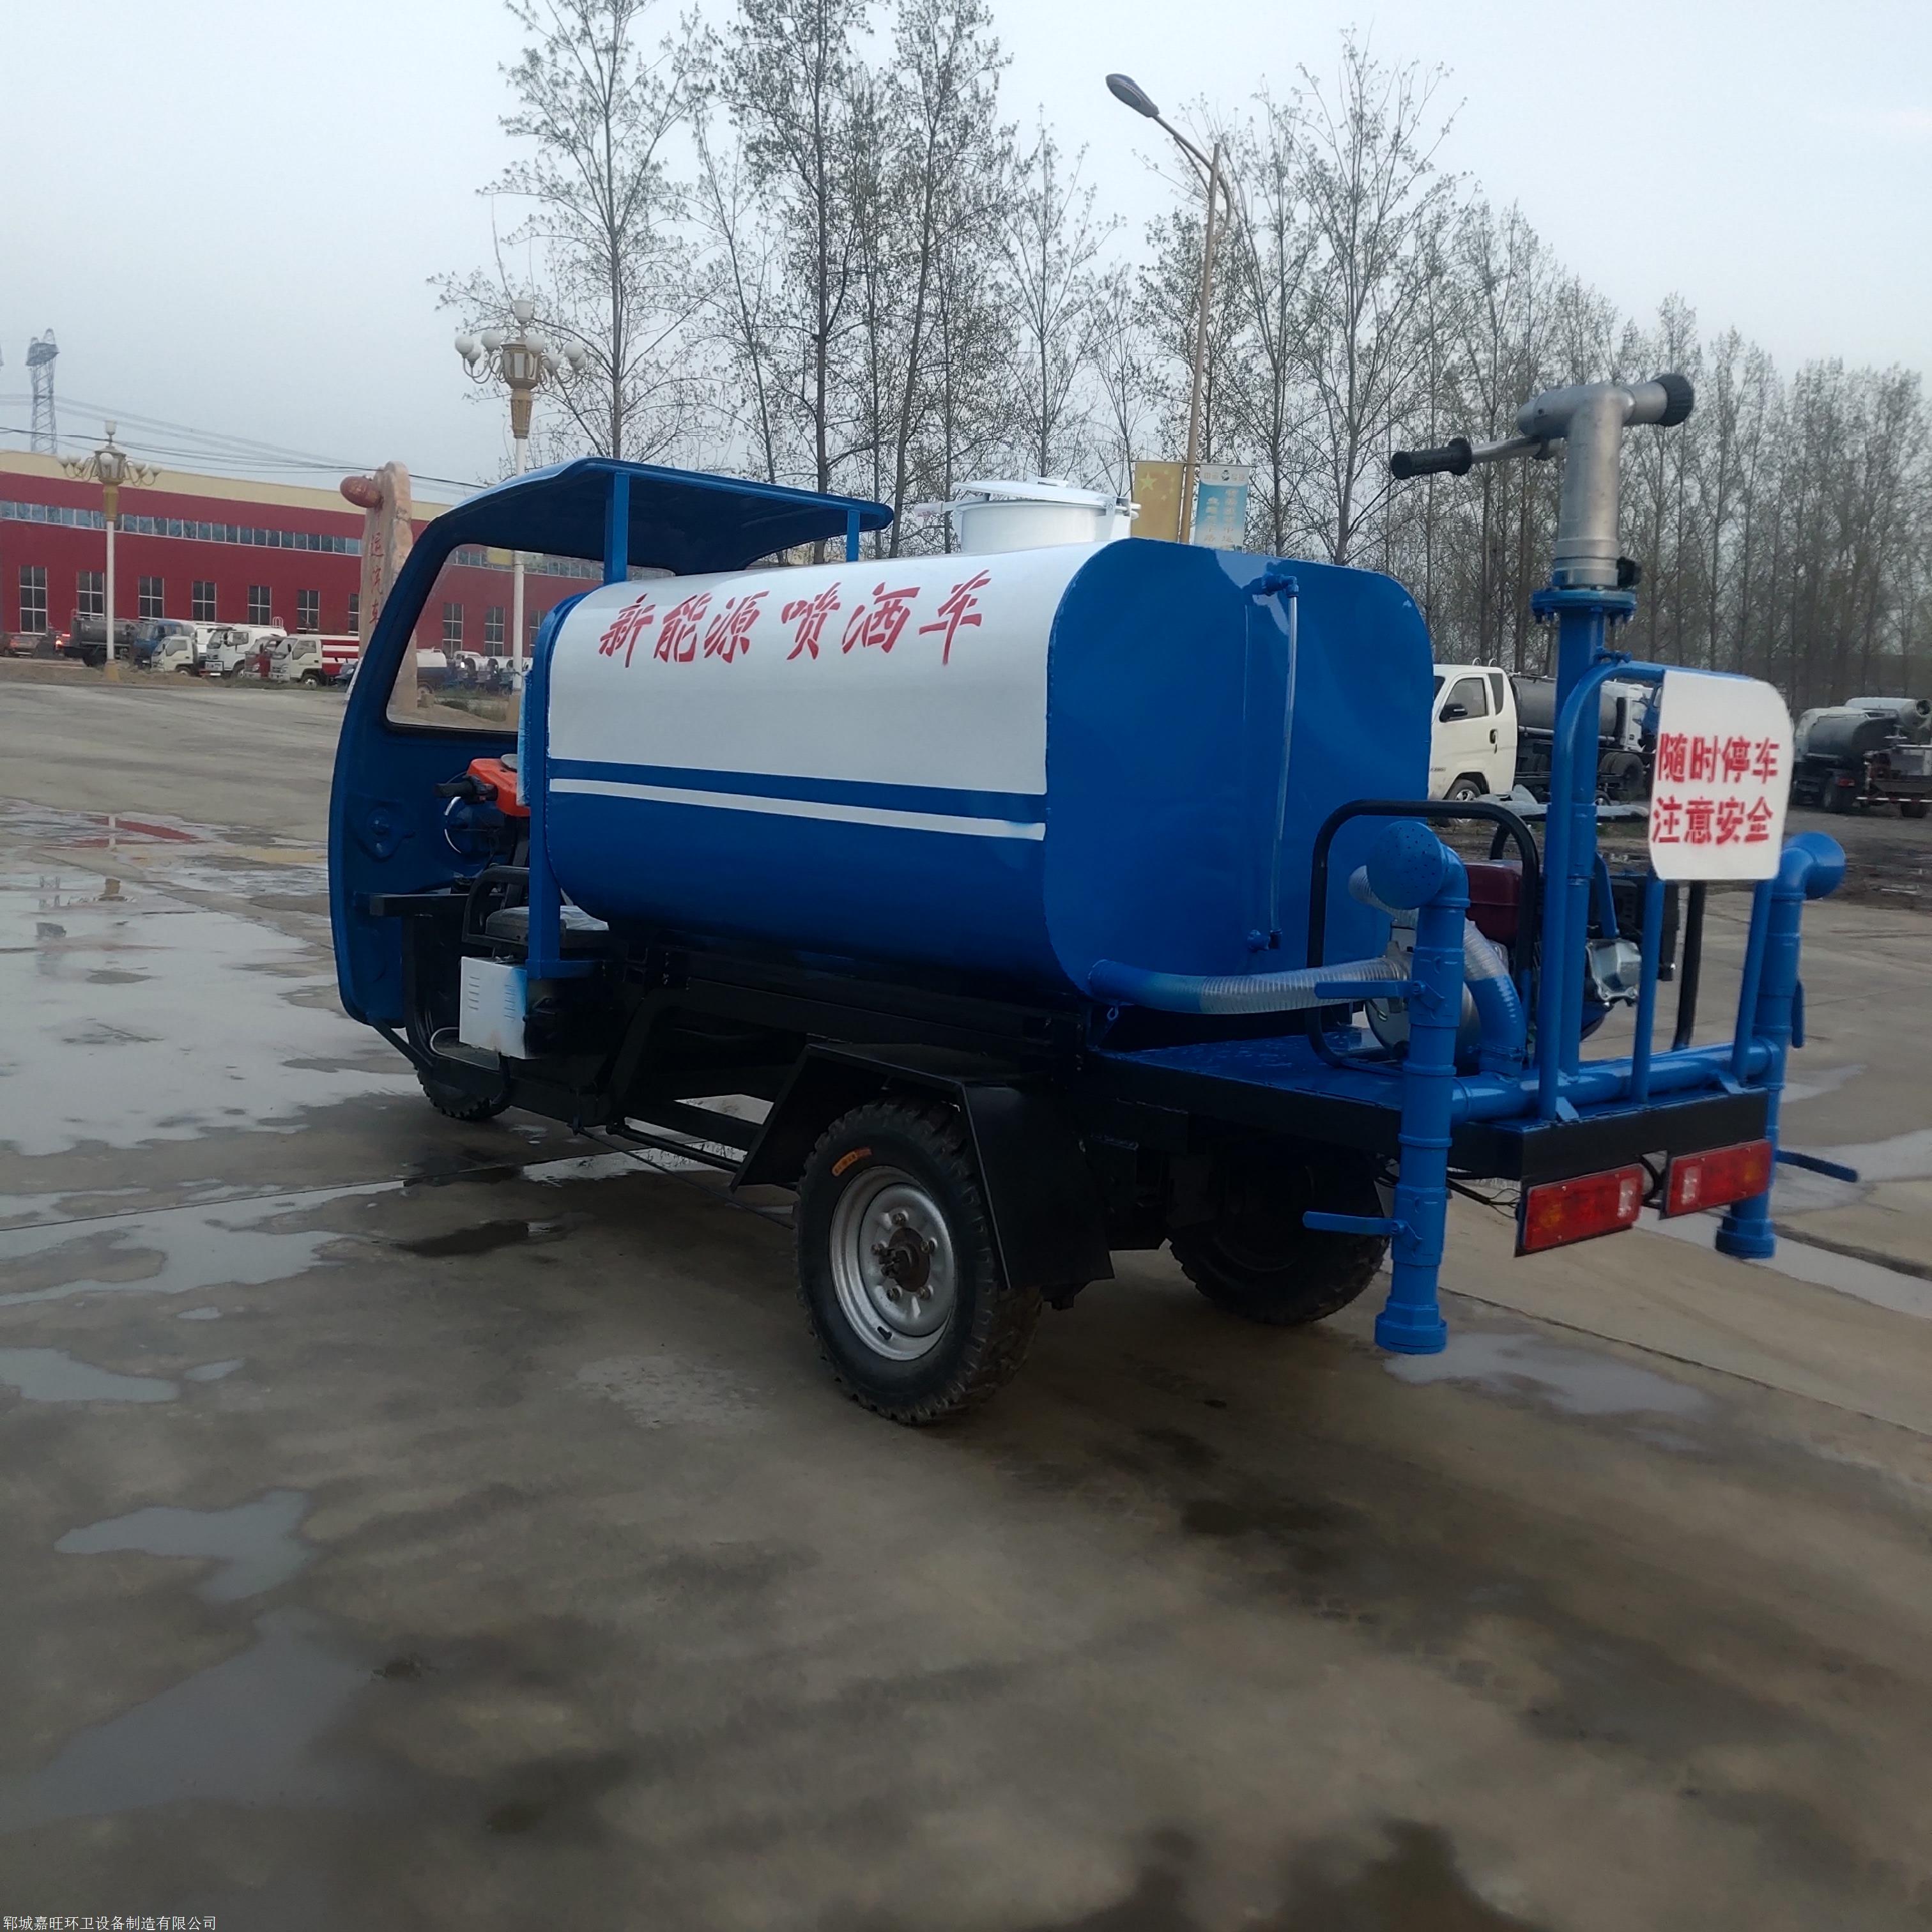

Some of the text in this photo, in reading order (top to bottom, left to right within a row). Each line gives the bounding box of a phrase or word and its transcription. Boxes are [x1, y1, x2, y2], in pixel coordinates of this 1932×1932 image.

[598, 569, 992, 668] 新能源喷洒车
[1658, 733, 1780, 784] 随时停车
[1652, 795, 1774, 845] 注意安全
